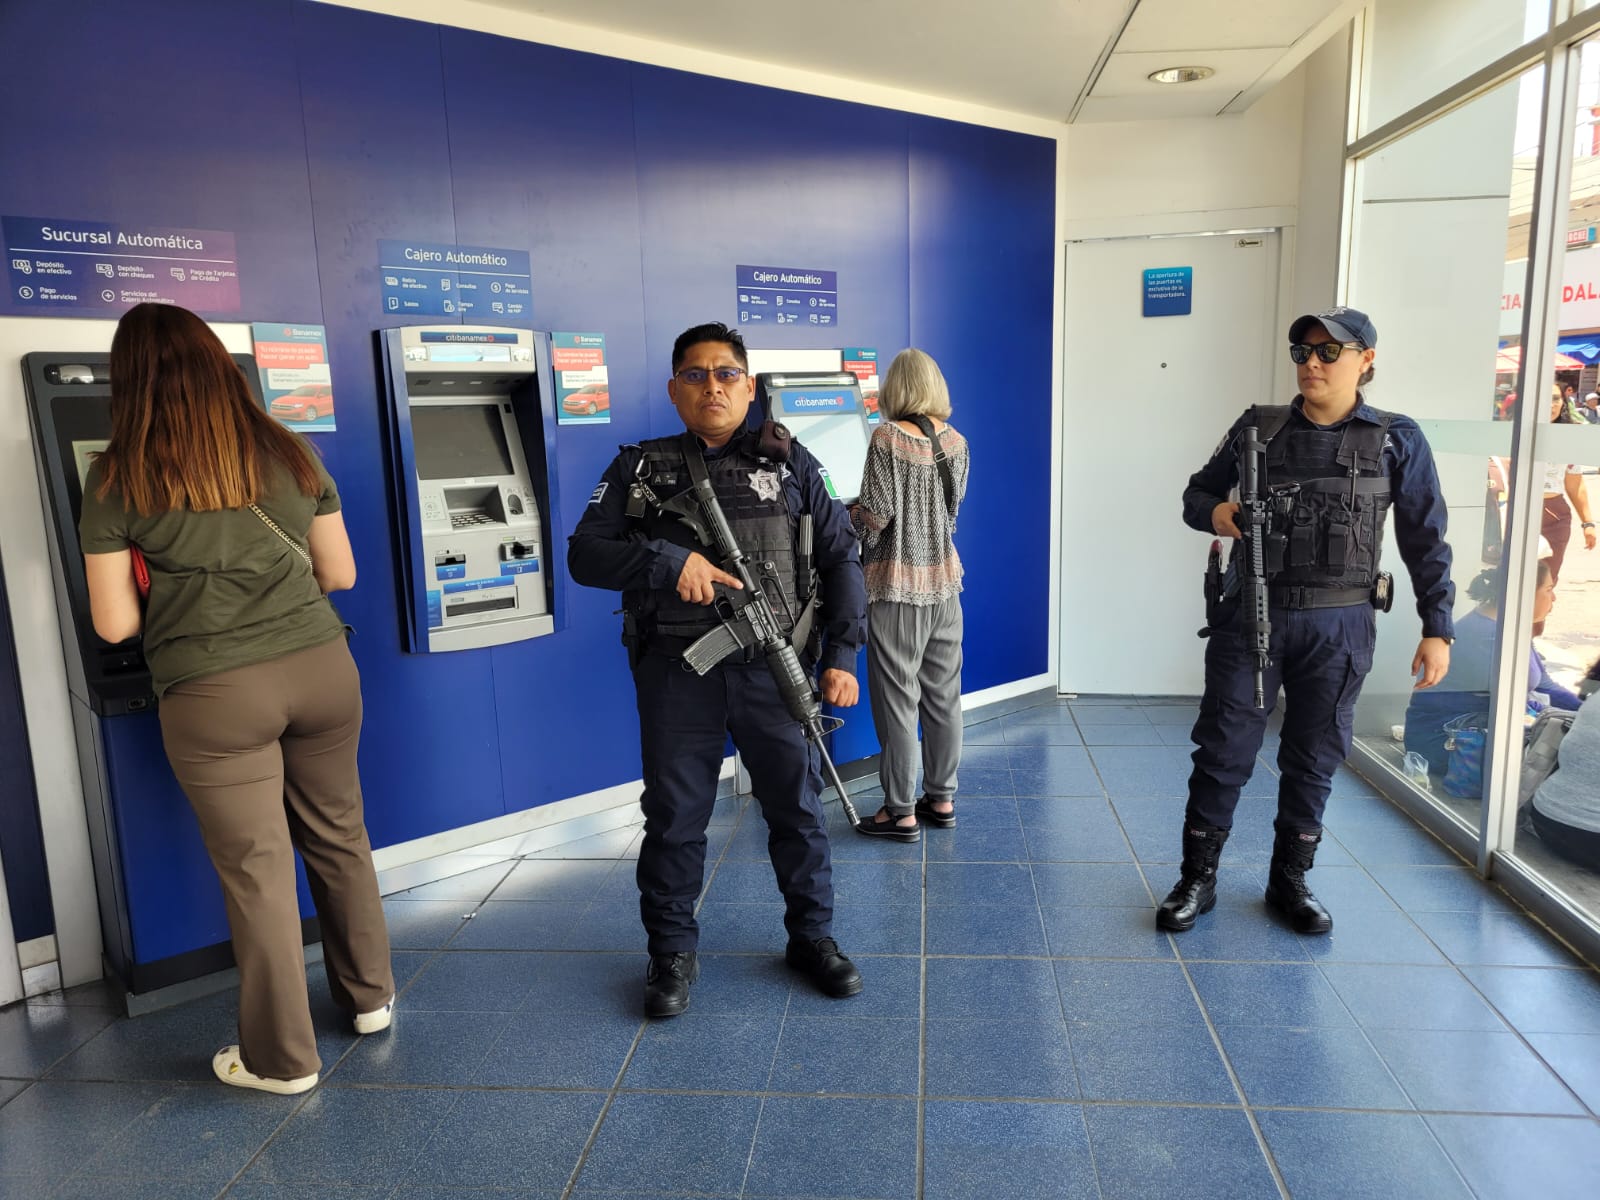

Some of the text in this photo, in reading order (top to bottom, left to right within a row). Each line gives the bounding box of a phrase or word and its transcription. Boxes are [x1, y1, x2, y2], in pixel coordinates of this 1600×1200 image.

[41, 226, 203, 250] Sucursal Automática
[405, 248, 507, 266] Cajero Automático
[36, 261, 64, 269] Depósito
[214, 270, 236, 278] Tarjetas
[753, 271, 822, 285] Cajero Automático
[40, 287, 56, 295] Pago
[292, 328, 322, 337] Banamex
[446, 334, 488, 343] citibanamex
[795, 397, 837, 407] citibanamex
